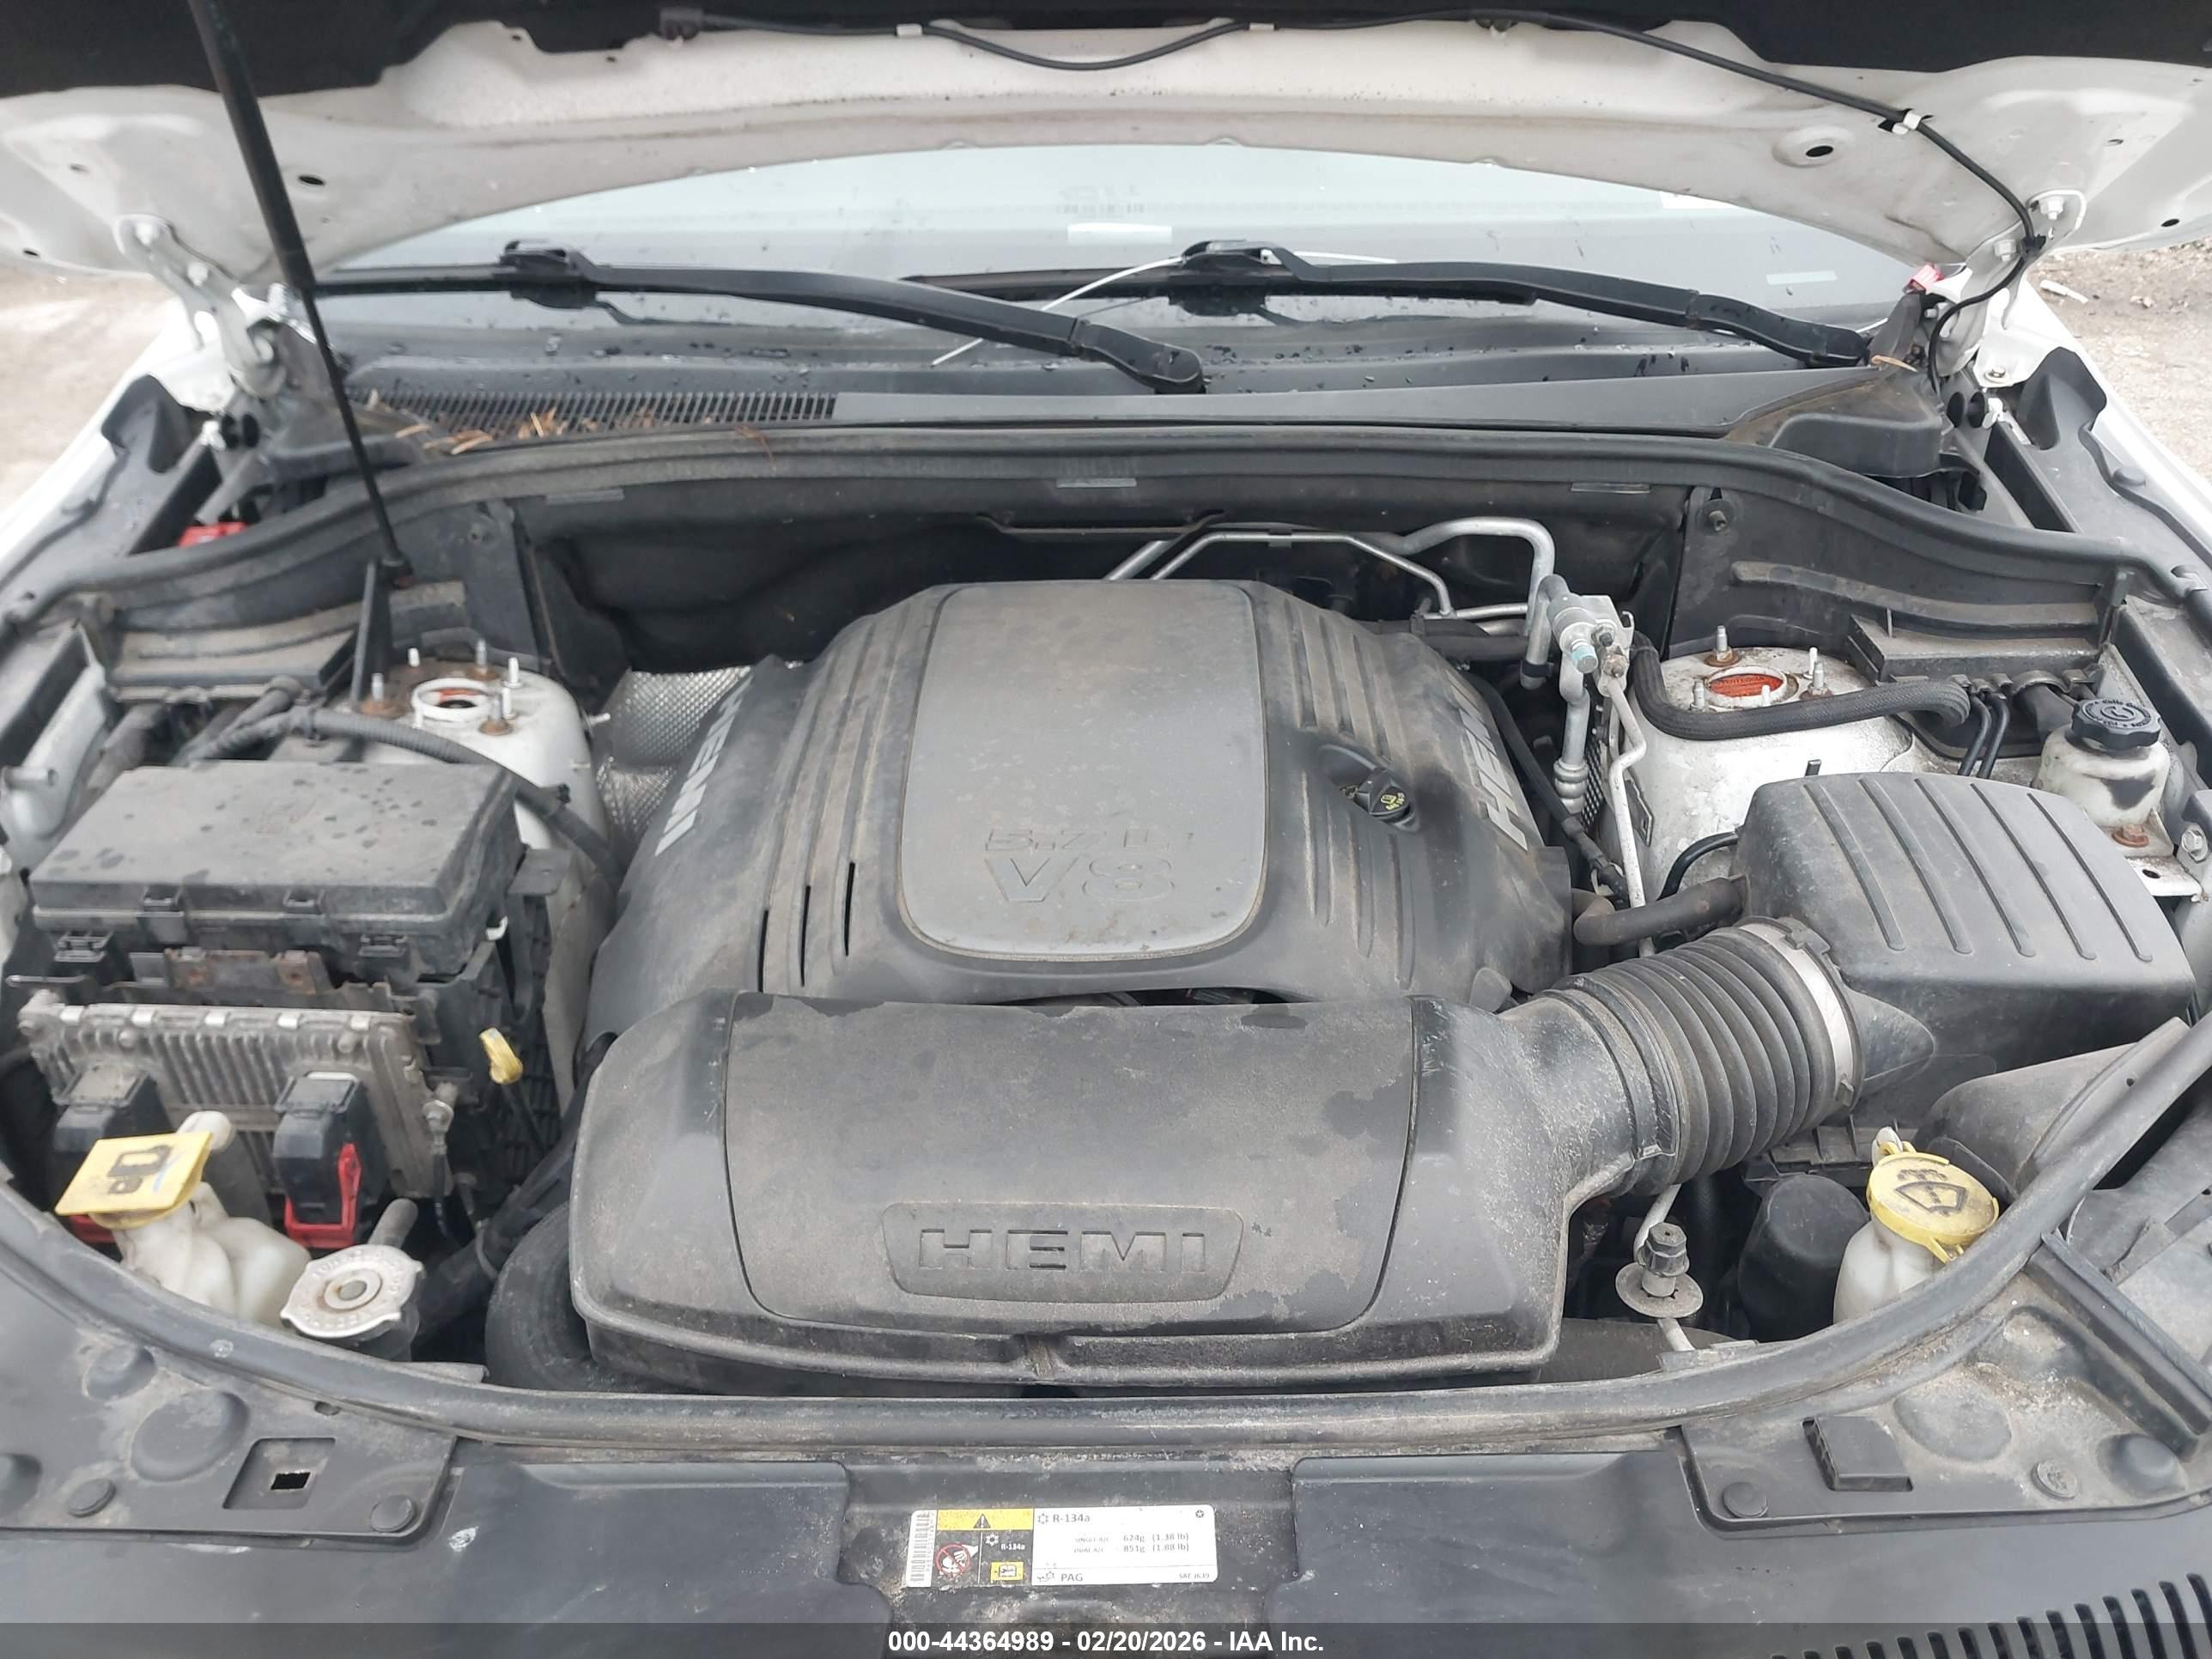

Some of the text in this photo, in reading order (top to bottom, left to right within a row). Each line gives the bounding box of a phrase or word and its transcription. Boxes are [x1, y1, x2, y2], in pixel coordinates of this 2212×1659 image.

[983, 857, 1175, 902] V8
[919, 1228, 1206, 1272] HEMI
[1053, 1514, 1091, 1523] R-134a
[1123, 1534, 1146, 1543] 624g
[1123, 1544, 1146, 1553] 851g
[1060, 1573, 1084, 1582] PAG
